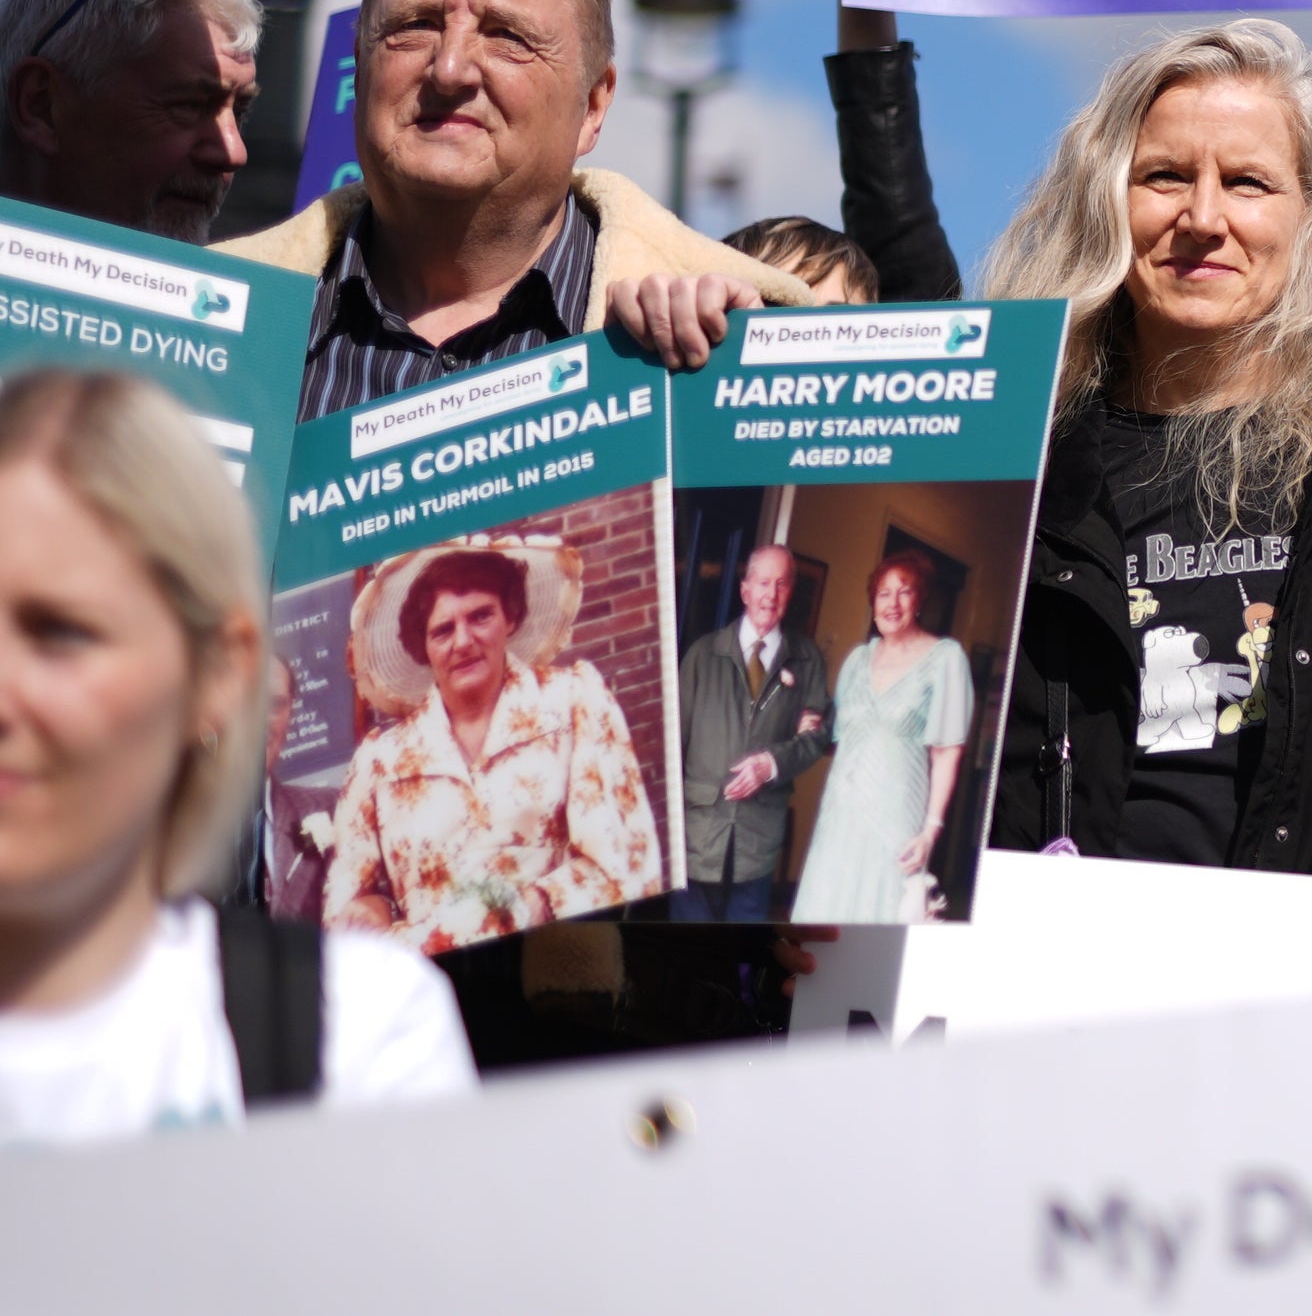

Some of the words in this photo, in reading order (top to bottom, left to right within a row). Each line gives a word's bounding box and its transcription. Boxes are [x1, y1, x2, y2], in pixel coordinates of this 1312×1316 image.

[8, 240, 69, 269] Death
[74, 255, 103, 278] My
[106, 264, 188, 298] Decision
[130, 328, 229, 373] DYING
[749, 328, 774, 345] My
[778, 326, 831, 342] Death
[836, 324, 862, 343] My
[866, 323, 941, 339] Decision
[355, 419, 379, 439] My
[383, 402, 435, 427] Death
[440, 392, 465, 413] My
[468, 369, 543, 402] Decision
[714, 373, 849, 408] HARRY
[852, 369, 997, 404] MOORE
[734, 420, 786, 440] DIED
[788, 419, 819, 439] BY
[820, 414, 961, 437] STARVATION
[289, 461, 405, 523] MAVIS
[411, 385, 653, 482] CORKINDALE
[789, 447, 850, 467] AGED
[852, 446, 893, 466] 102
[342, 511, 391, 543] DIED
[394, 505, 416, 527] IN
[419, 479, 514, 520] TURMOIL
[517, 467, 540, 489] IN
[543, 451, 595, 482] 2015
